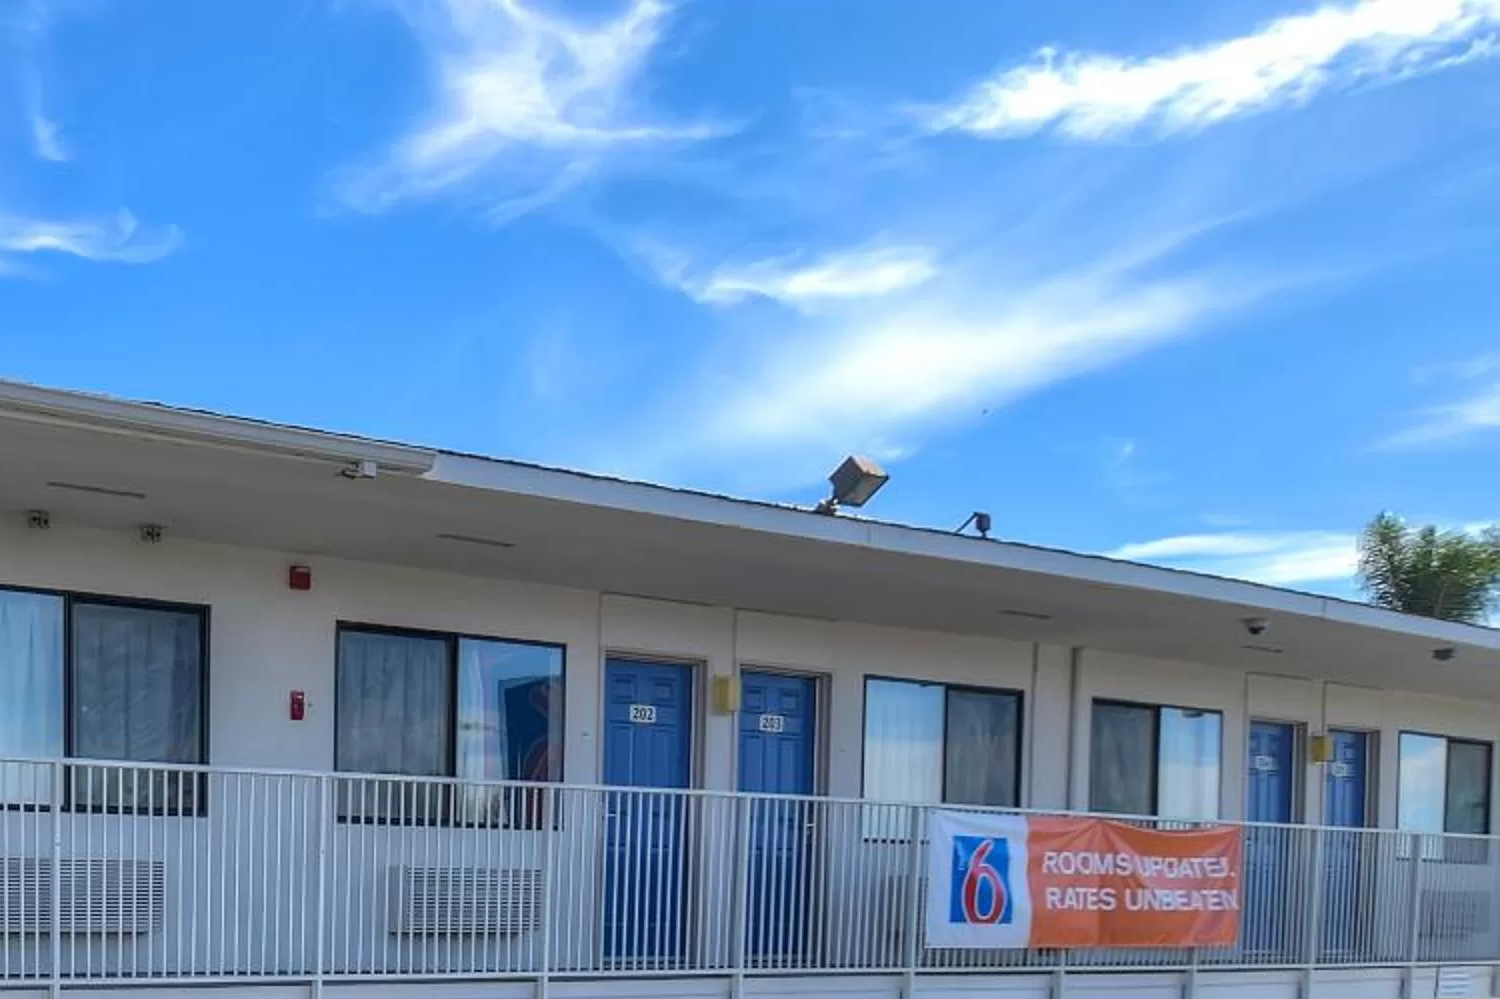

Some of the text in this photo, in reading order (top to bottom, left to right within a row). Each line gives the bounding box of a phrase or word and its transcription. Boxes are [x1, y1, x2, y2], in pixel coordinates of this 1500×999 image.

[632, 706, 654, 721] 202
[1042, 851, 1134, 877] ROOMS
[962, 838, 1007, 925] 6
[1045, 886, 1117, 910] RATES
